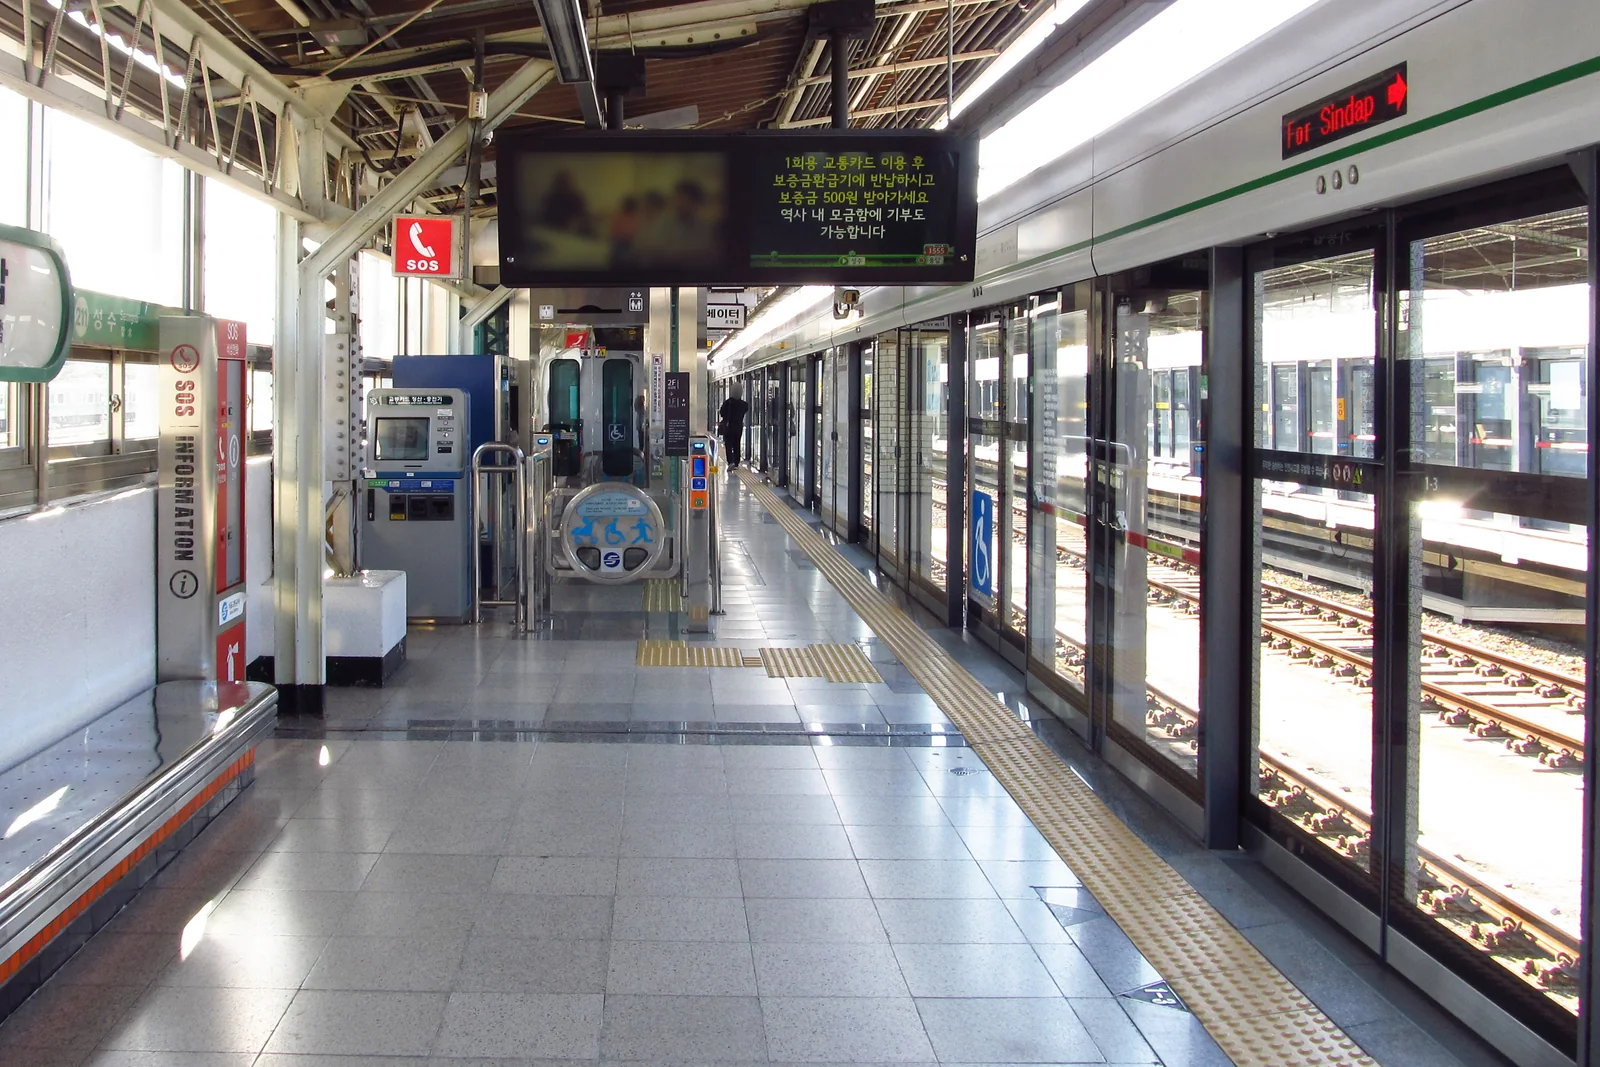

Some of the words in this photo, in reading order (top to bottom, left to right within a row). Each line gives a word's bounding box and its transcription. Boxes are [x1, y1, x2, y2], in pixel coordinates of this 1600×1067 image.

[1287, 121, 1311, 149] For
[1320, 95, 1375, 135] Sindap
[785, 156, 818, 170] 1회용
[823, 156, 877, 170] 교통카드
[881, 156, 907, 170] 이용
[912, 156, 925, 170] 후
[773, 174, 865, 188] 보증금환급기에
[870, 174, 936, 188] 반납하시고
[779, 191, 818, 205] 보증금
[823, 191, 859, 205] 500원
[864, 191, 929, 205] 받아가세요
[781, 208, 807, 222] 역사
[812, 208, 825, 222] 내
[829, 208, 882, 222] 모금함에
[887, 208, 926, 222] 기부도
[820, 225, 886, 239] 가능합니다
[406, 259, 439, 271] SOS
[93, 308, 117, 333] 성수
[227, 322, 239, 340] SOS
[175, 380, 195, 417] SOS
[1424, 476, 1439, 492] 1-3
[174, 436, 194, 561] INFORMATION
[1144, 988, 1177, 1004] 1-3
